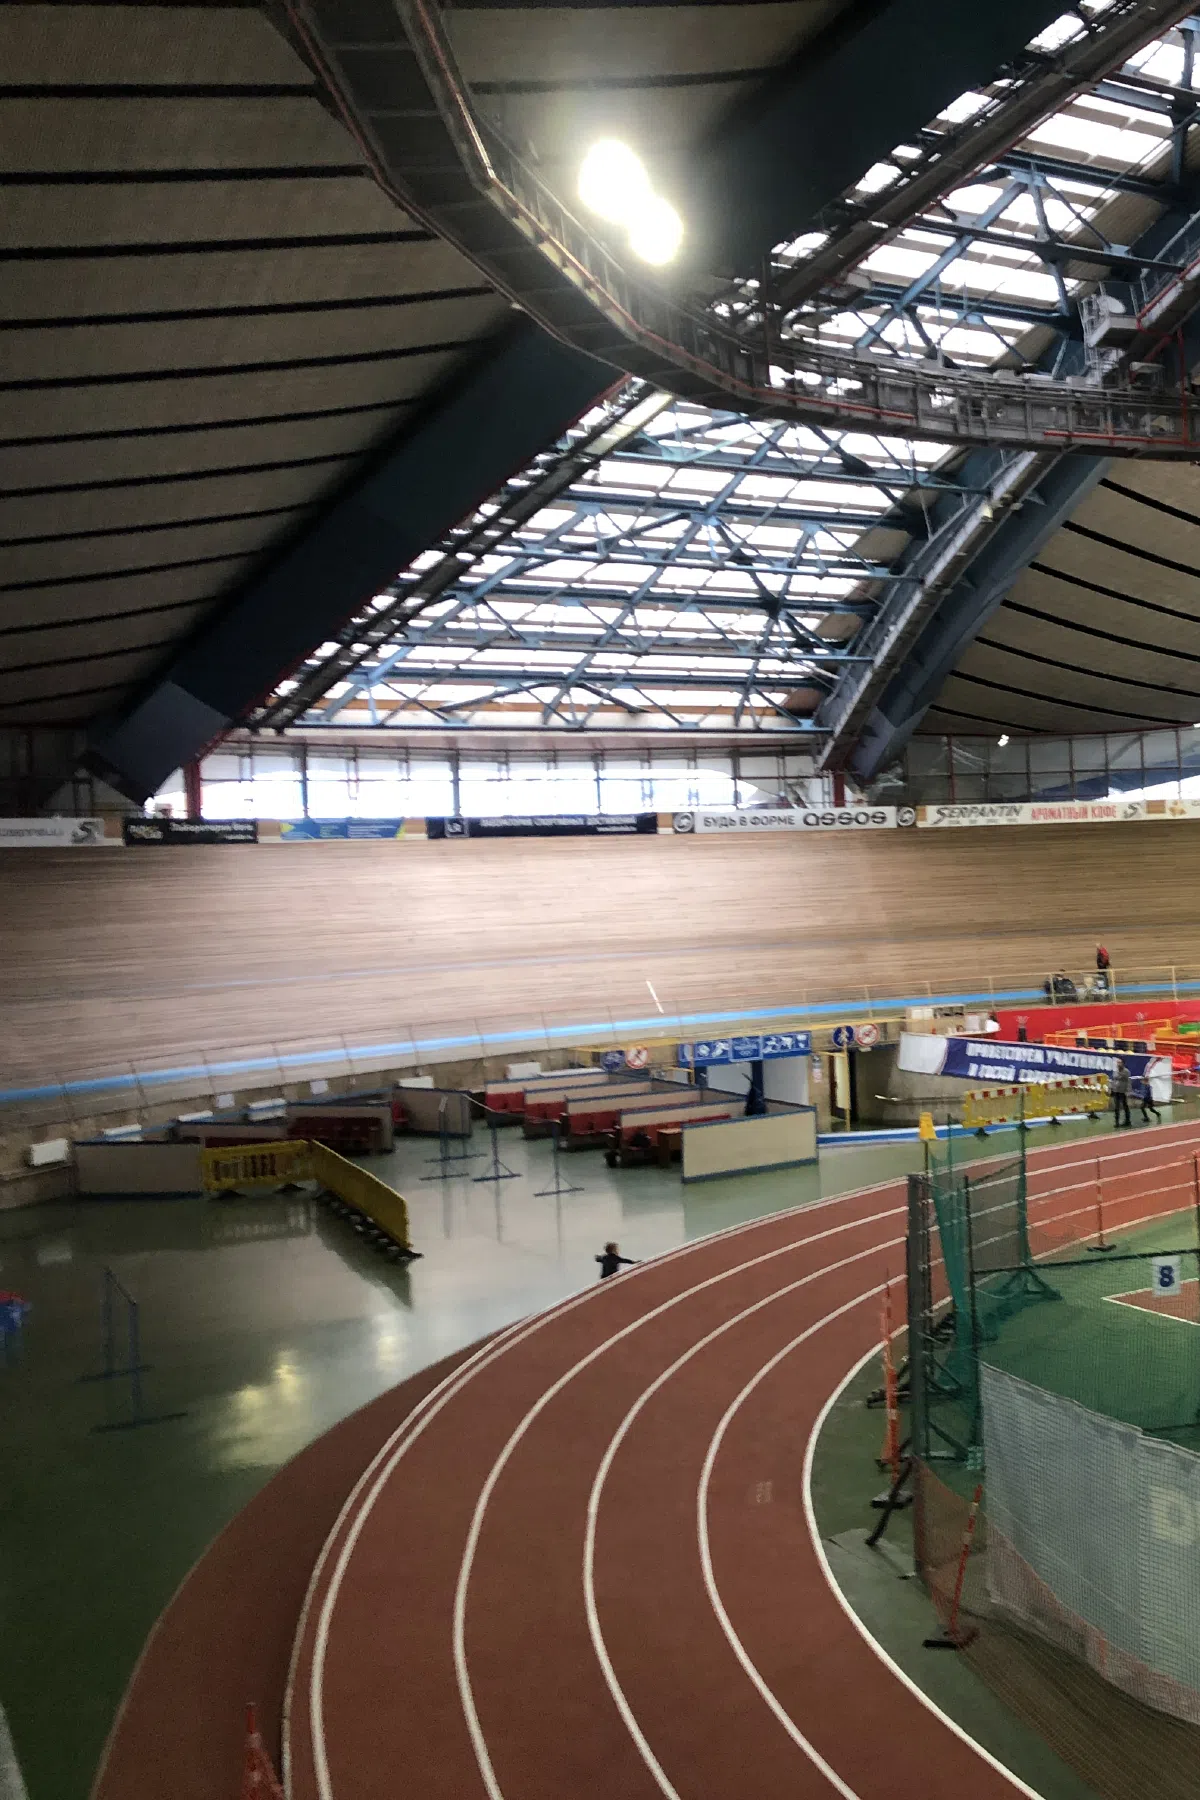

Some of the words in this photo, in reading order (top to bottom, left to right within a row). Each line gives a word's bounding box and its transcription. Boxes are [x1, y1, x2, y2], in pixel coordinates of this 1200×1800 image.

[703, 816, 737, 828] БУДЬ
[740, 816, 748, 826] В
[749, 815, 796, 826] ФОРМЕ
[1159, 1265, 1175, 1288] 8
